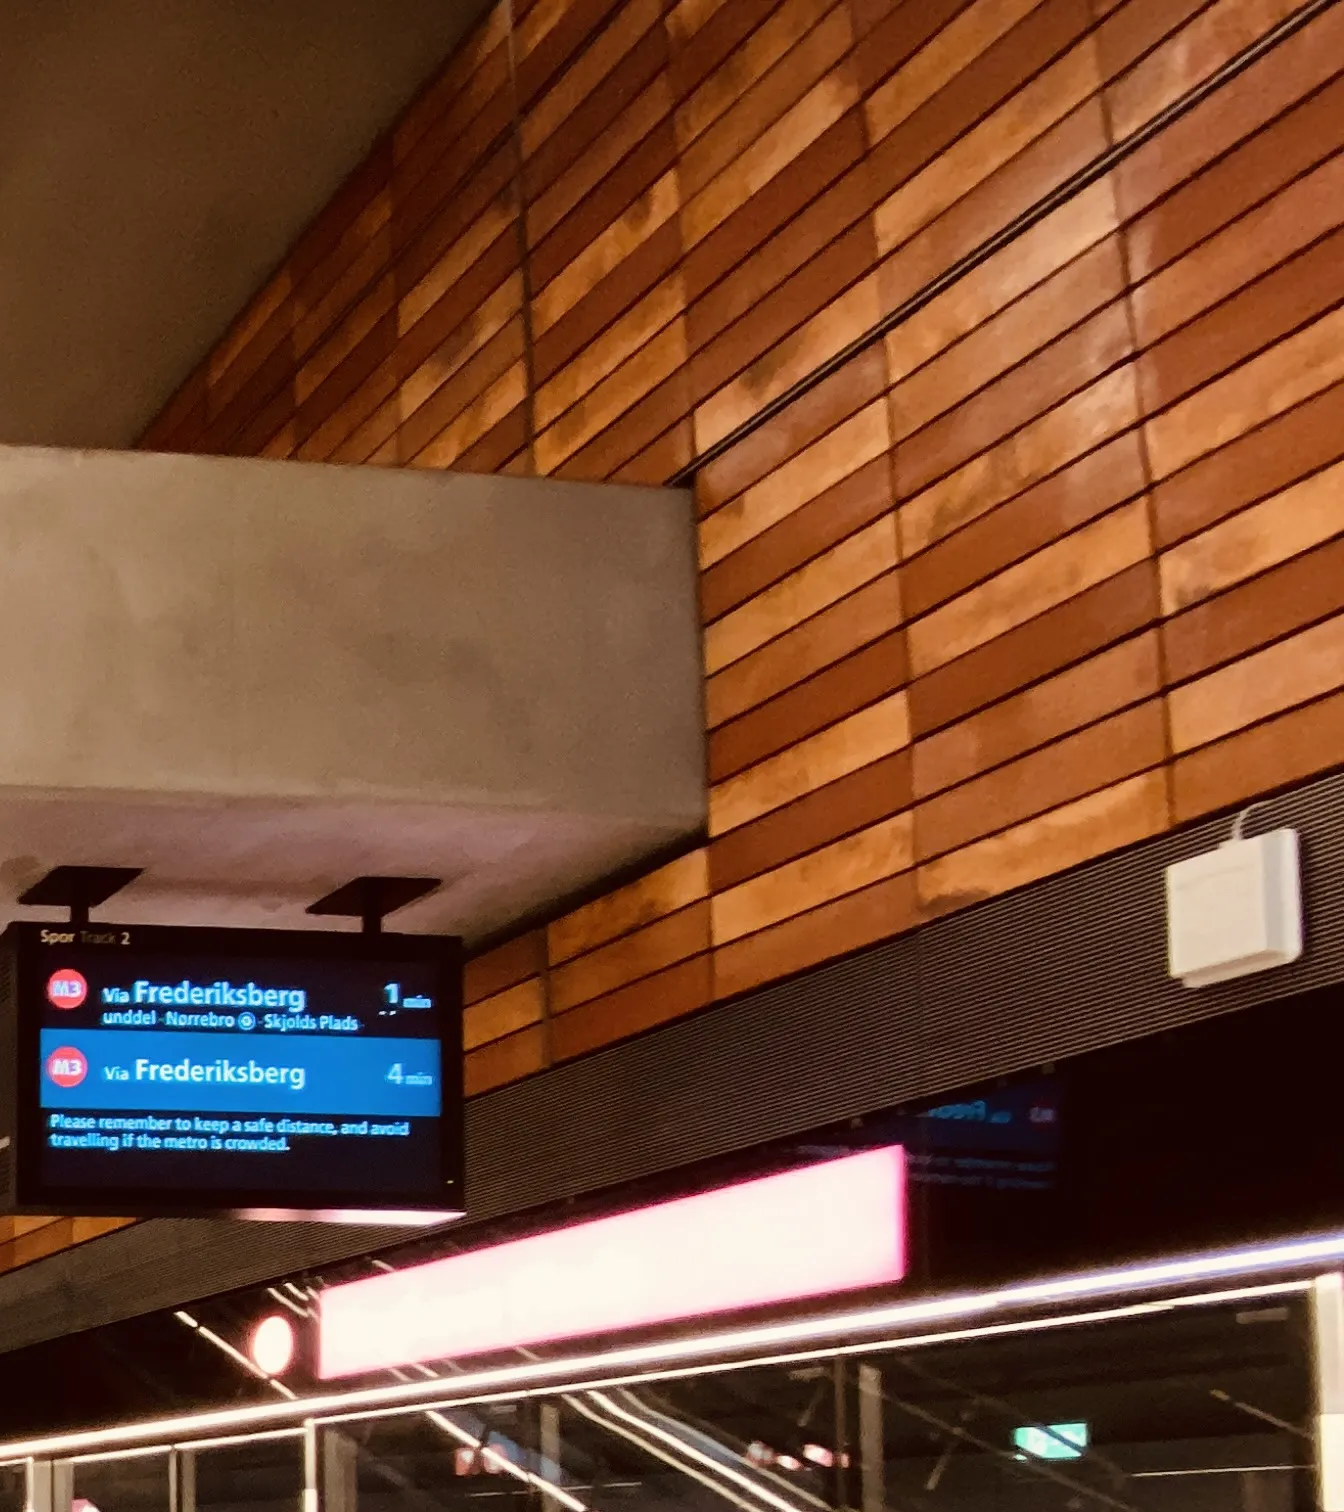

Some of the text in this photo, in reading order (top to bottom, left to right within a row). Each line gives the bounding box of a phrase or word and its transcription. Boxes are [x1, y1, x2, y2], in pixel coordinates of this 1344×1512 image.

[40, 929, 75, 945] Spor
[120, 932, 130, 945] 2
[52, 980, 82, 997] M3
[102, 987, 130, 1003] Via
[134, 980, 306, 1012] Frederiksberg
[383, 983, 399, 1003] 1
[165, 1010, 235, 1028] Nørrebro
[263, 1013, 316, 1032] Skjolds
[319, 1015, 358, 1030] Plads
[52, 1058, 82, 1076] M3
[104, 1066, 129, 1081] Via
[135, 1058, 305, 1090] Frederiksberg
[386, 1062, 403, 1084] 4
[50, 1114, 410, 1136] Please remember to keep a safe distance, and avoid
[49, 1133, 291, 1151] travelling if the metro is crowded.
